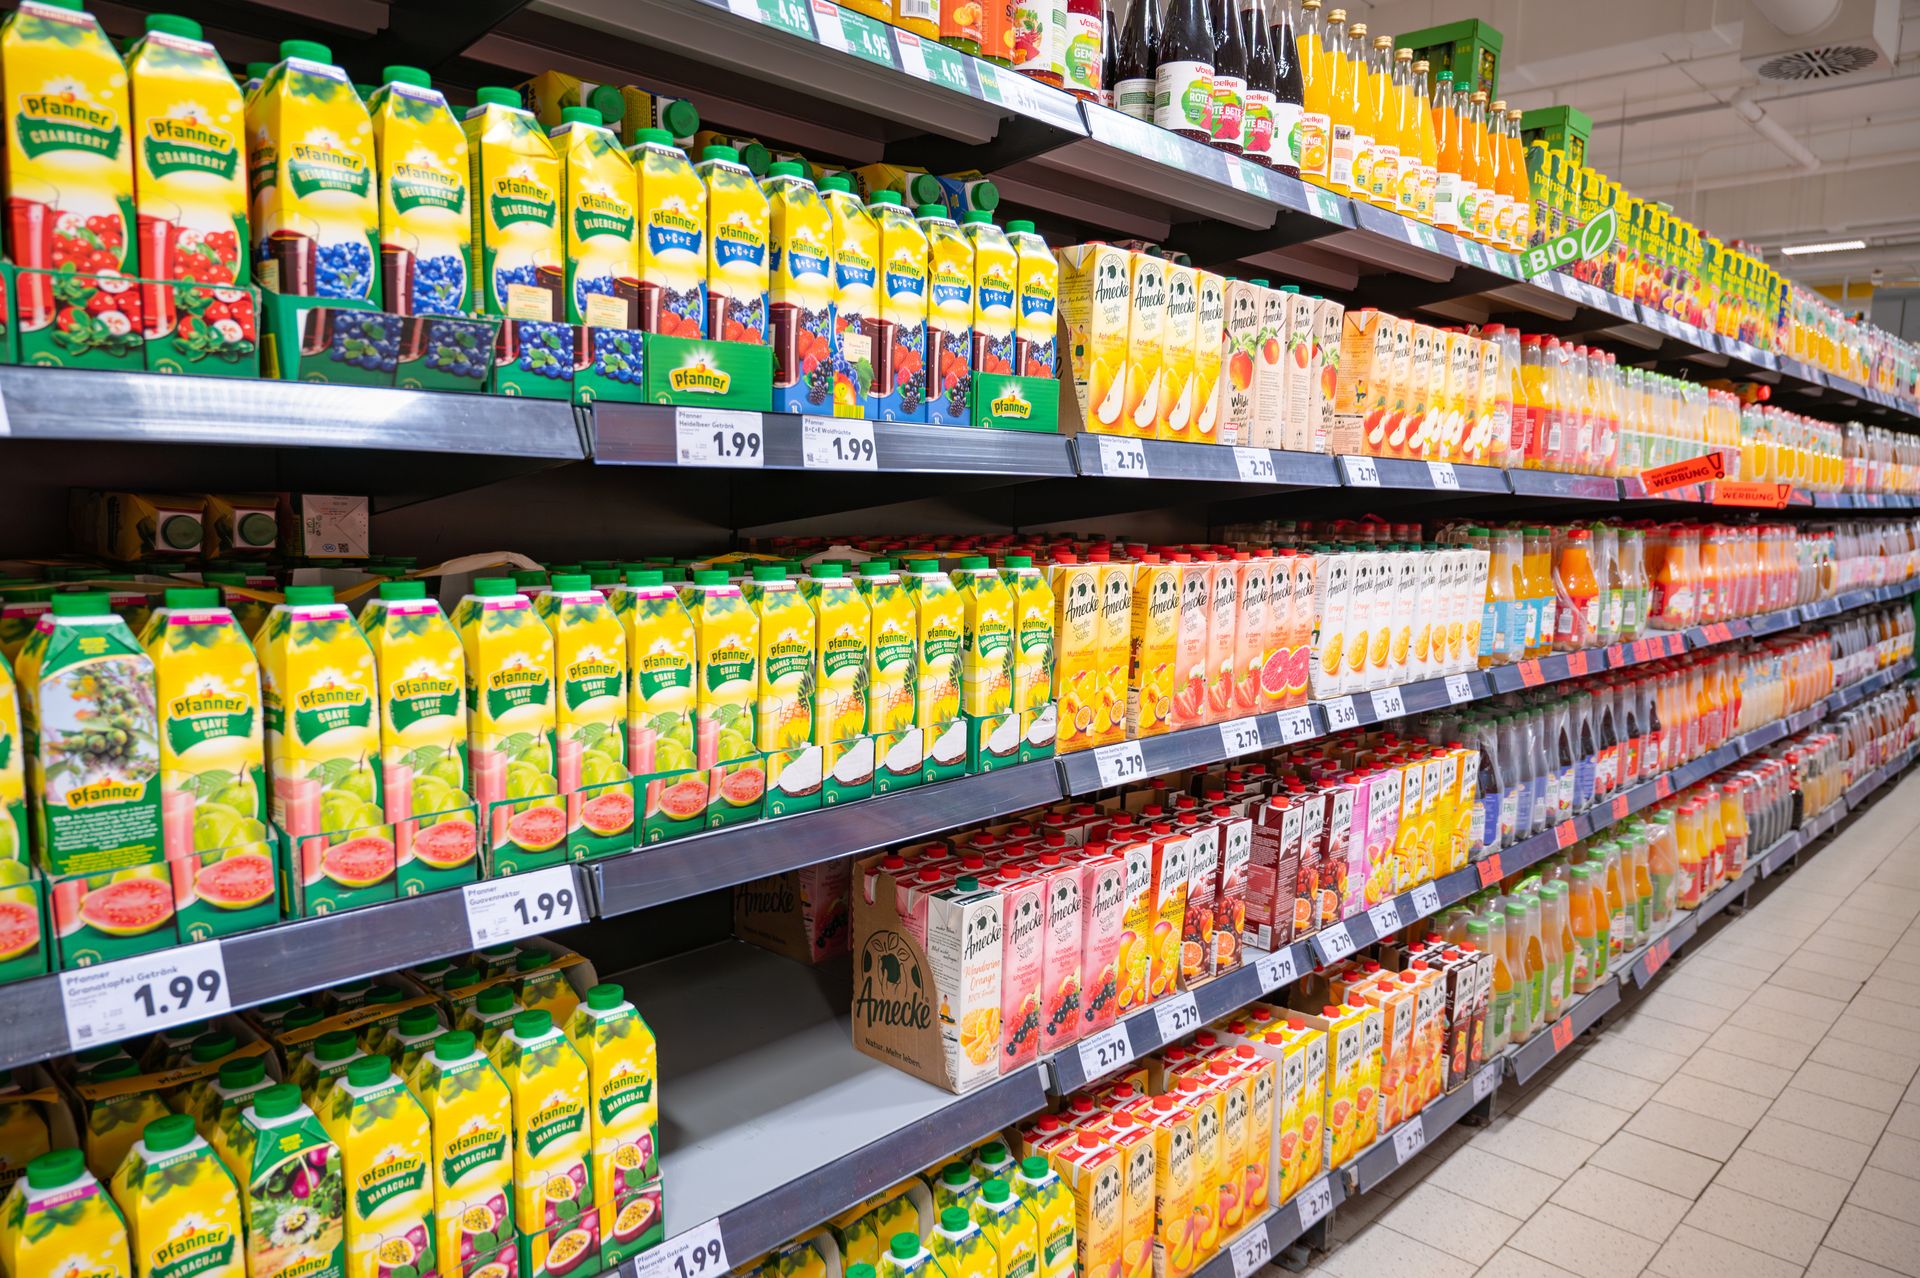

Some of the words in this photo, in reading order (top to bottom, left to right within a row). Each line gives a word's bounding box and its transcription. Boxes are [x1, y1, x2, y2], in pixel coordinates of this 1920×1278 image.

[863, 30, 890, 60] 4.95
[942, 60, 967, 88] 4.95
[1214, 80, 1238, 88] oelkel
[26, 97, 110, 127] Pfanner
[29, 129, 110, 151] CRANBERRY
[153, 121, 227, 150] Pfanner
[155, 150, 227, 171] CRANBERRY
[295, 146, 359, 169] Pfanner
[397, 164, 455, 187] Pfanner
[498, 180, 548, 202] Pfanner
[501, 204, 548, 220] BLUEBERRY
[581, 194, 627, 217] Pfanner
[583, 216, 626, 233] BLUEBERRY
[653, 211, 696, 232] Pfanner
[657, 232, 691, 246] B+C+E
[720, 224, 760, 245] Pfanner
[723, 248, 755, 261] B+C+E
[791, 240, 823, 258] Pfanner
[838, 249, 870, 267] Pfanner
[1529, 237, 1578, 273] BIO
[889, 261, 919, 278] Pfanner
[982, 275, 1010, 291] Pfanner
[1025, 284, 1052, 299] Pfanner
[1095, 278, 1129, 304] Amecke
[1134, 286, 1166, 311] Amecke
[1166, 294, 1196, 318] Amecke
[1199, 302, 1223, 324] Amecke
[1231, 312, 1257, 332] Amecke
[675, 372, 726, 390] Pfanner
[994, 402, 1028, 414] Pfanner
[713, 431, 761, 458] 1.99
[833, 437, 874, 462] 1.99
[1116, 450, 1144, 469] 2.79
[1250, 460, 1273, 476] 2.79
[1358, 467, 1377, 482] 2.79
[1653, 466, 1710, 488] WERBUNG
[1722, 492, 1774, 501] WERBUNG
[1268, 582, 1293, 604] Amecke
[1294, 582, 1314, 602] Amecke
[1328, 578, 1348, 598] Amecke
[1353, 576, 1373, 596] Amecke
[1065, 594, 1099, 622] Amecke
[1101, 592, 1131, 619] Amecke
[1149, 591, 1180, 618] Amecke
[1181, 591, 1207, 616] Amecke
[1213, 589, 1236, 610] Amecke
[1242, 588, 1268, 610] Amecke
[927, 627, 956, 639] Pfanner
[980, 621, 1007, 632] Pfanner
[1022, 620, 1048, 630] Pfanner
[771, 643, 807, 656] Pfanner
[828, 637, 862, 650] Pfanner
[878, 632, 908, 646] Pfanner
[644, 656, 684, 669] Pfanner
[711, 650, 750, 663] Pfanner
[493, 672, 543, 686] Pfanner
[570, 663, 615, 678] Pfanner
[653, 672, 676, 683] GUAVE
[720, 665, 741, 676] GUAVE
[397, 681, 452, 697] Pfanner
[505, 688, 532, 700] GUAVE
[582, 680, 606, 693] GUAVE
[1456, 684, 1470, 698] 3.69
[175, 700, 243, 715] Pfanner
[301, 690, 361, 708] Pfanner
[411, 699, 441, 712] GUAVE
[1384, 698, 1400, 713] 3.69
[192, 718, 229, 732] GUAVE
[317, 708, 350, 723] GUAVE
[1337, 706, 1356, 723] 3.69
[1292, 718, 1312, 736] 2.79
[1236, 729, 1258, 748] 2.79
[1115, 754, 1143, 776] 2.79
[71, 786, 140, 805] Pfanner
[1190, 851, 1217, 877] Amecke
[1226, 841, 1249, 872] Amecke
[1126, 872, 1150, 899] Amecke
[1160, 865, 1189, 891] Amecke
[514, 888, 573, 925] 1.99
[1092, 889, 1124, 918] Amecke
[1421, 893, 1438, 910] 2.79
[1049, 897, 1082, 928] Amecke
[1382, 912, 1398, 929] 2.79
[1010, 911, 1044, 945] Amecke
[964, 926, 1001, 960] Amecke
[1331, 933, 1352, 953] 2.79
[1270, 961, 1291, 982] 2.79
[134, 969, 221, 1017] 1.99
[856, 977, 931, 1029] Amecke
[1172, 1005, 1197, 1030] 2.79
[1098, 1039, 1125, 1067] 2.79
[451, 1061, 480, 1075] MARACUJA
[364, 1087, 395, 1102] MARACUJA
[603, 1075, 645, 1095] Pfanner
[607, 1090, 644, 1112] MARACUJA
[1253, 1086, 1273, 1115] Amecke
[532, 1103, 578, 1127] Pfanner
[1224, 1103, 1249, 1134] Amecke
[536, 1118, 576, 1144] MARACUJA
[1406, 1128, 1423, 1151] 2.79
[449, 1130, 499, 1154] Pfanner
[453, 1148, 496, 1174] MARACUJA
[1170, 1143, 1195, 1175] Amecke
[363, 1158, 417, 1184] Pfanner
[1127, 1162, 1155, 1196] Amecke
[367, 1176, 415, 1204] MARACUJA
[1092, 1181, 1121, 1220] Amecke
[157, 1231, 225, 1263] Pfanner
[1246, 1240, 1268, 1268] 2.79
[674, 1239, 721, 1278] 1.99
